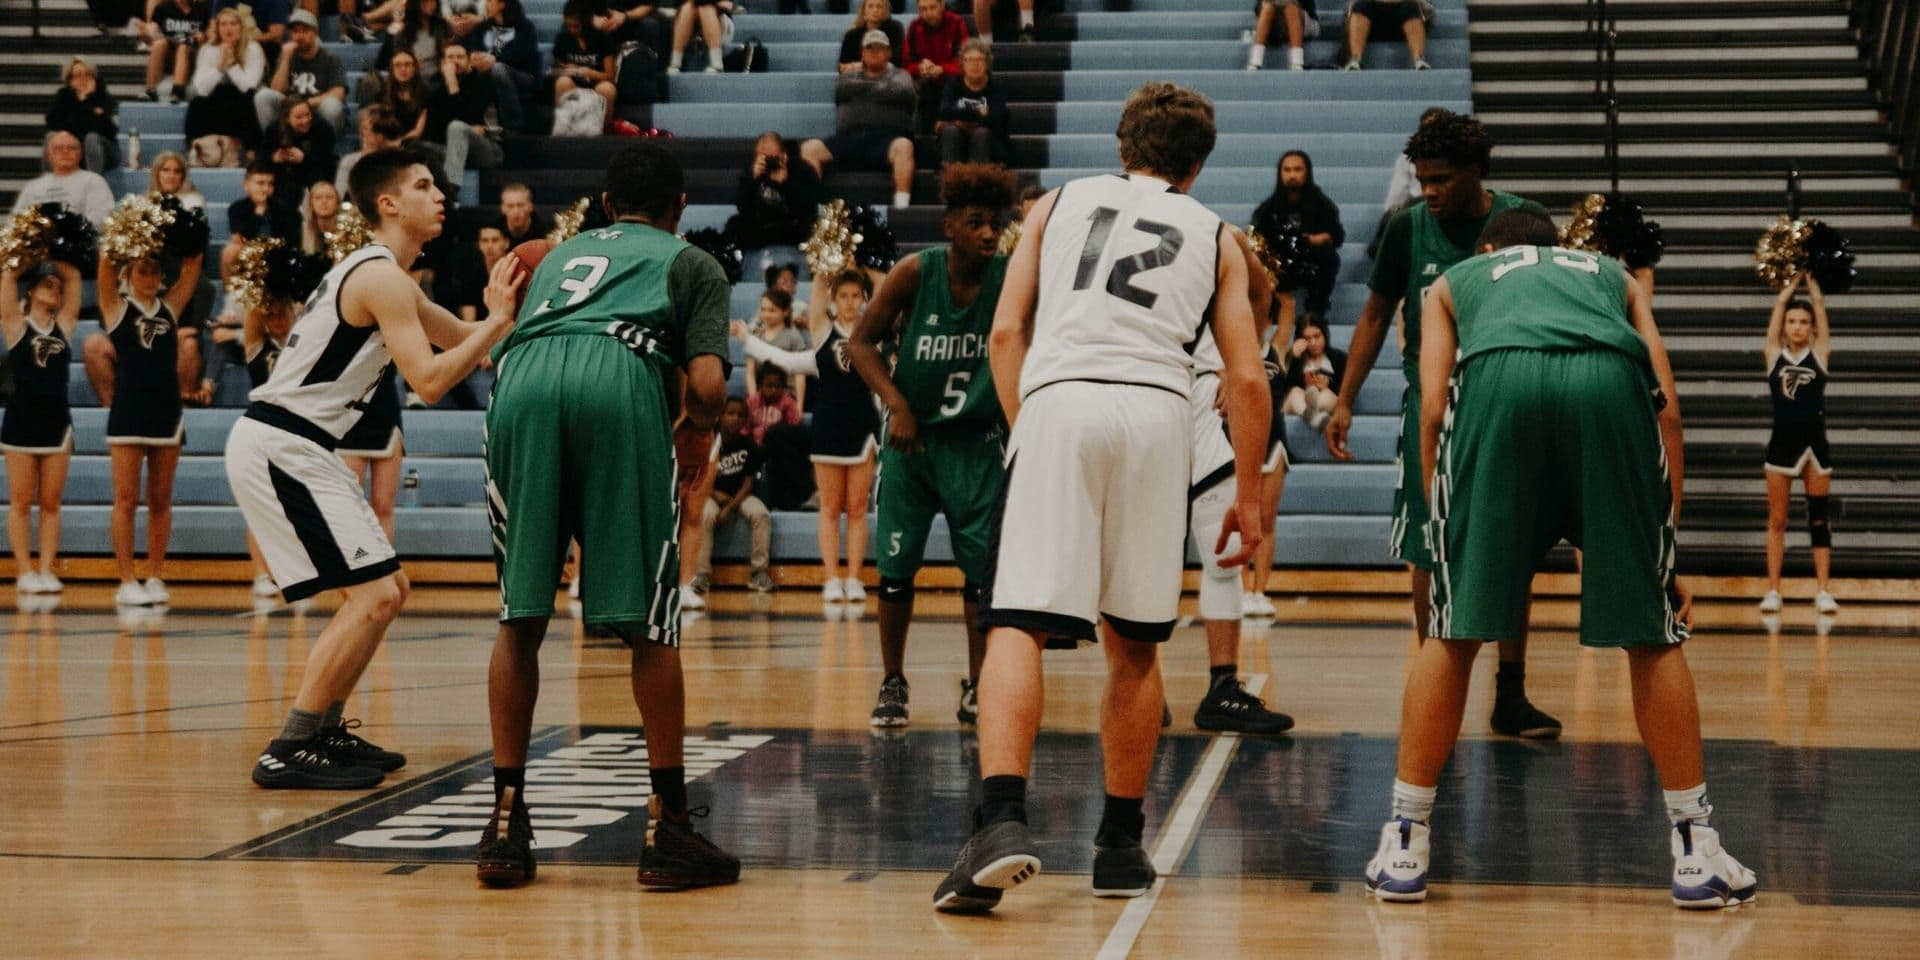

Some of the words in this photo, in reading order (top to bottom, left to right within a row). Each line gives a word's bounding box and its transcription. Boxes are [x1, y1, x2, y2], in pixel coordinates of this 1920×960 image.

[535, 254, 611, 316] 3
[1073, 205, 1183, 309] 12
[940, 371, 971, 417] 5
[888, 529, 903, 557] 5
[336, 732, 776, 850] SUNRISE
